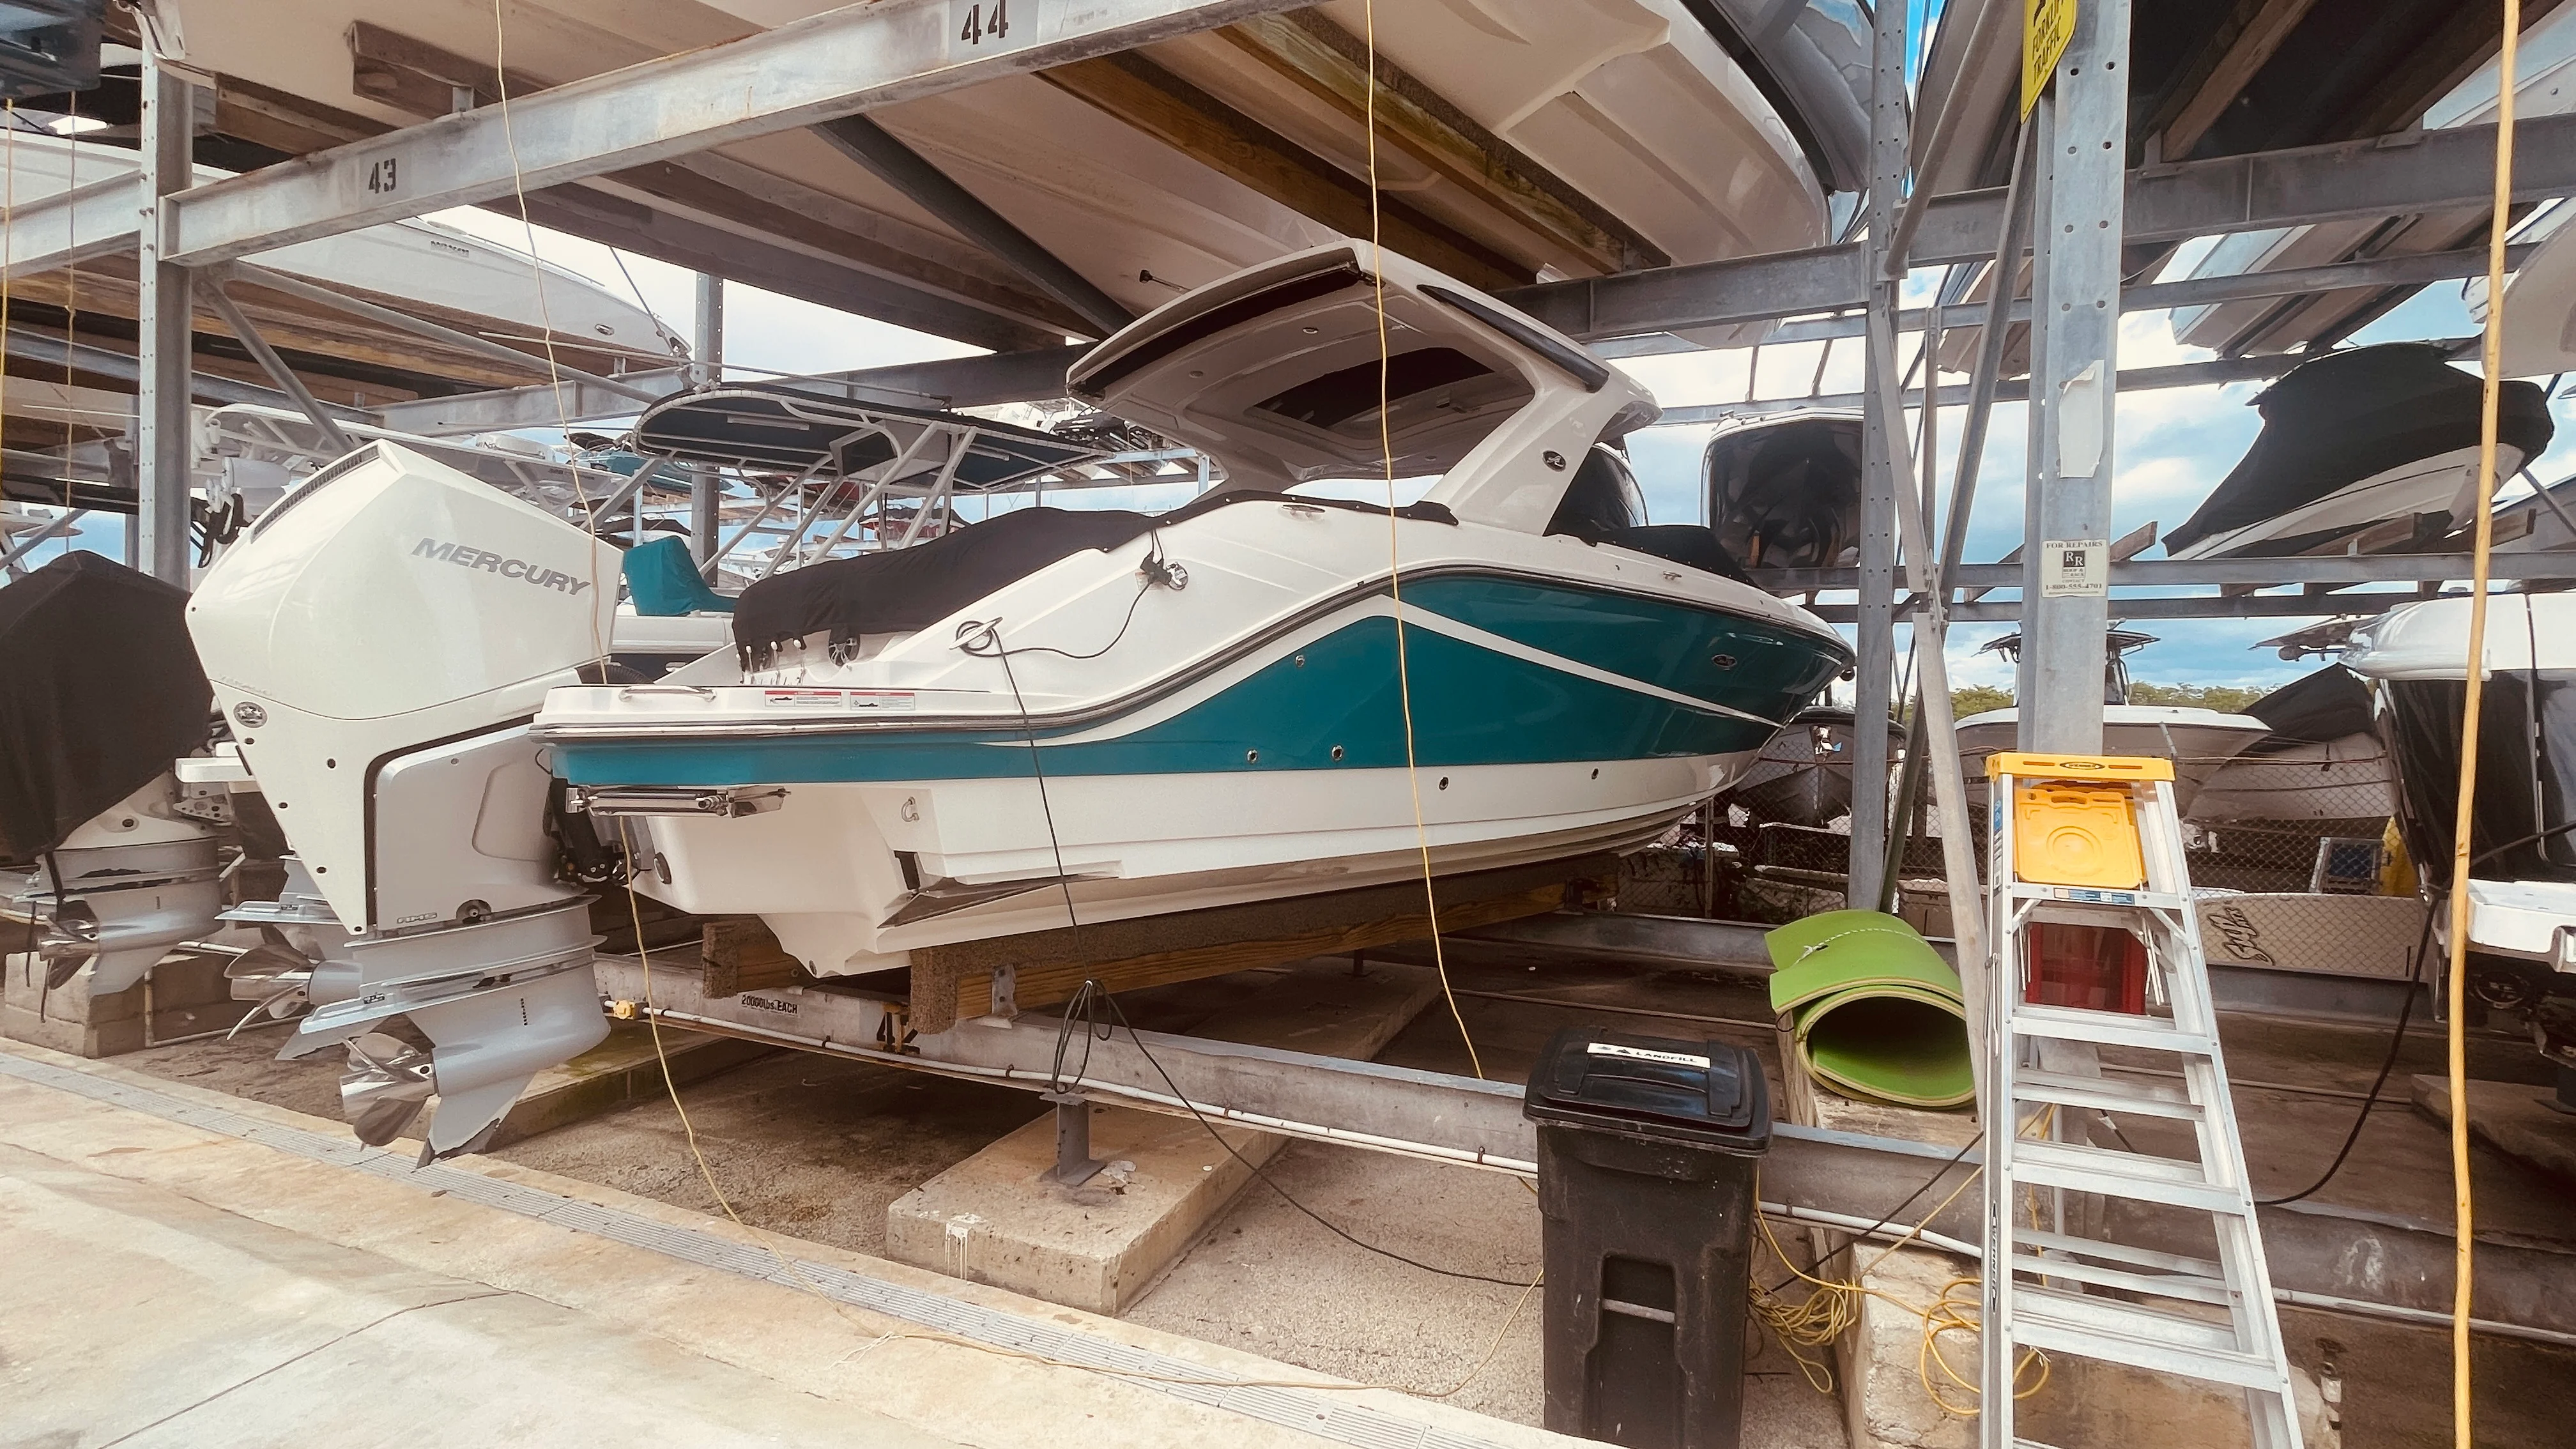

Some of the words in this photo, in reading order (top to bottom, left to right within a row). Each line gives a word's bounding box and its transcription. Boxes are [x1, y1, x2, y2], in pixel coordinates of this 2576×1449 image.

[962, 0, 1008, 45] 44
[2034, 15, 2062, 86] TRAFFIC
[368, 158, 396, 194] 43
[411, 537, 591, 595] MERCURY
[1636, 1052, 1698, 1063] LANDFILL
